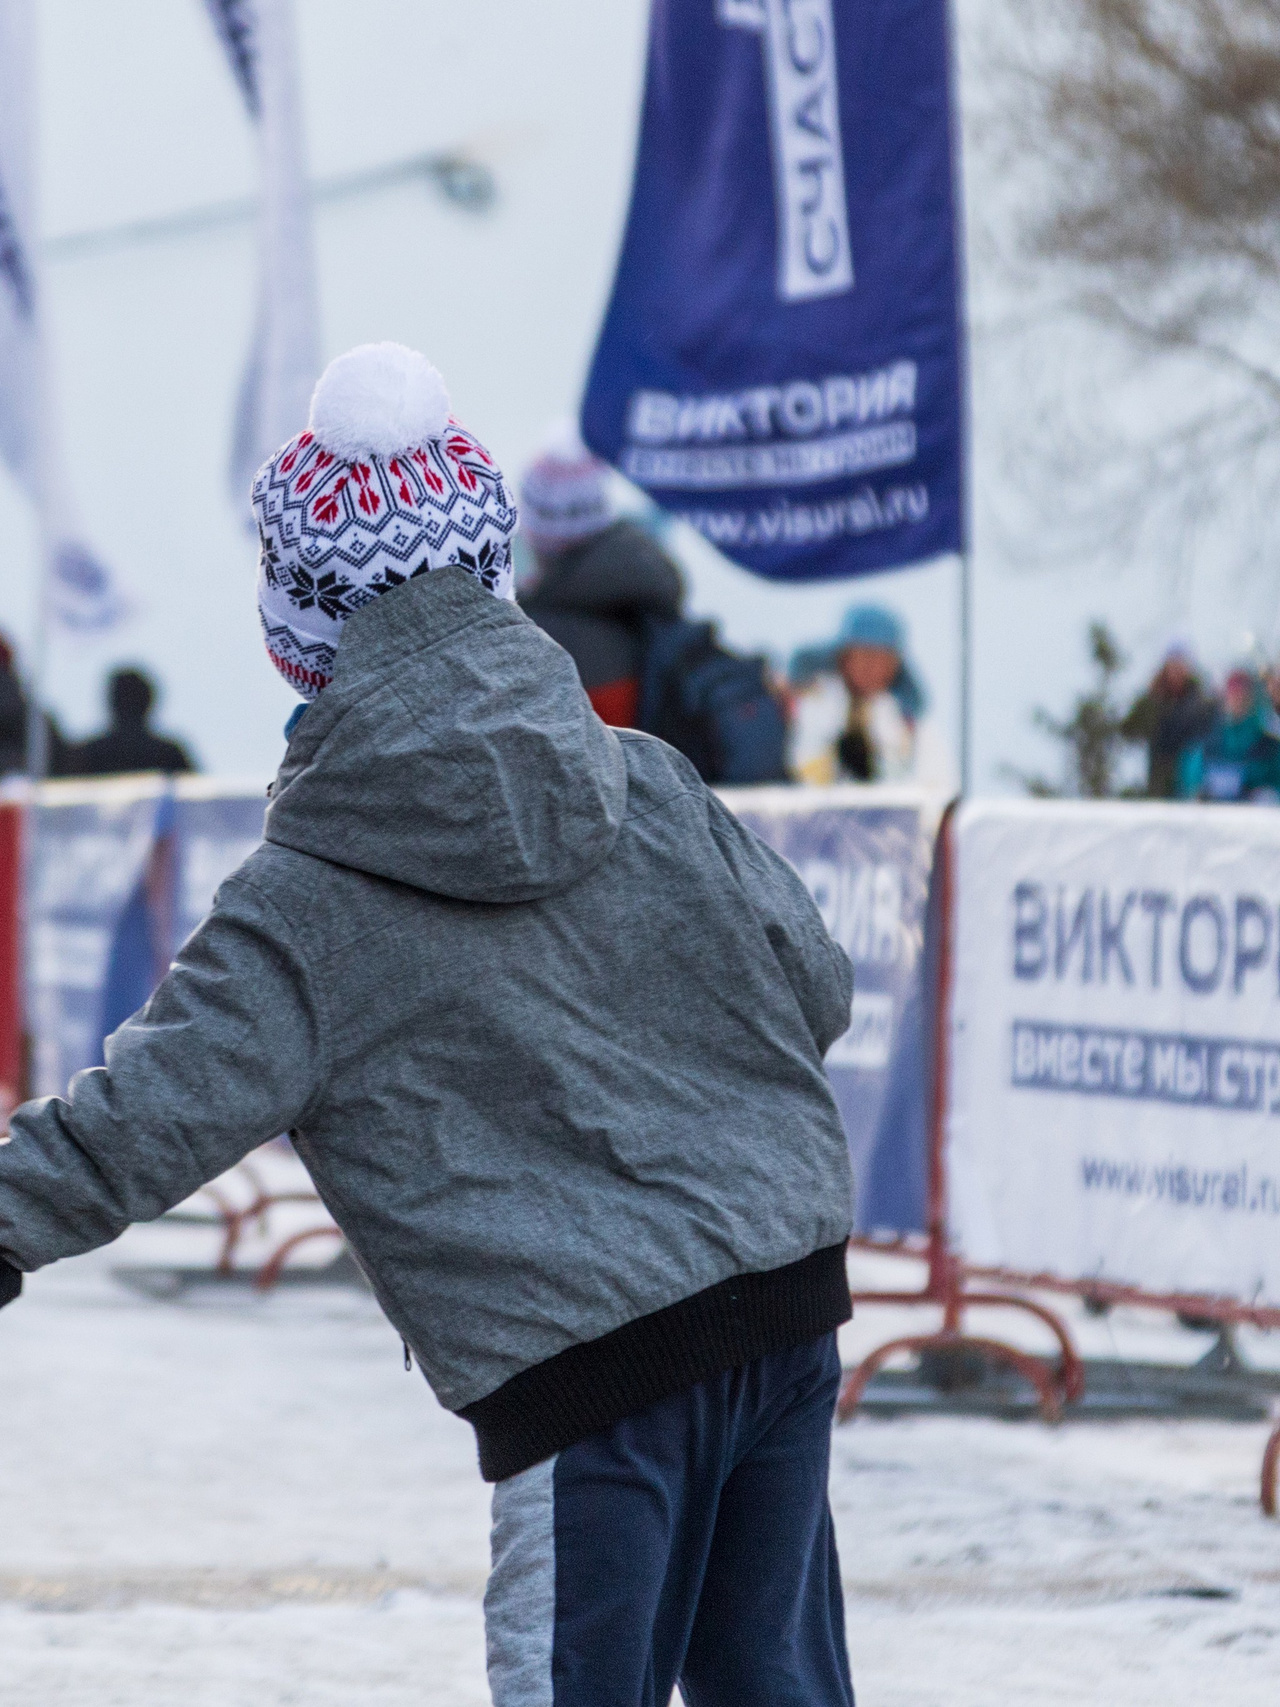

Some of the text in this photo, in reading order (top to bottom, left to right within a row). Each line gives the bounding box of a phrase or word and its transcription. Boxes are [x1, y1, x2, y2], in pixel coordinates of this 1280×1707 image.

[786, 0, 842, 277] СЧАС
[629, 361, 917, 440] ВИКТОРИЯ
[1013, 880, 1280, 996] ВИКТОР
